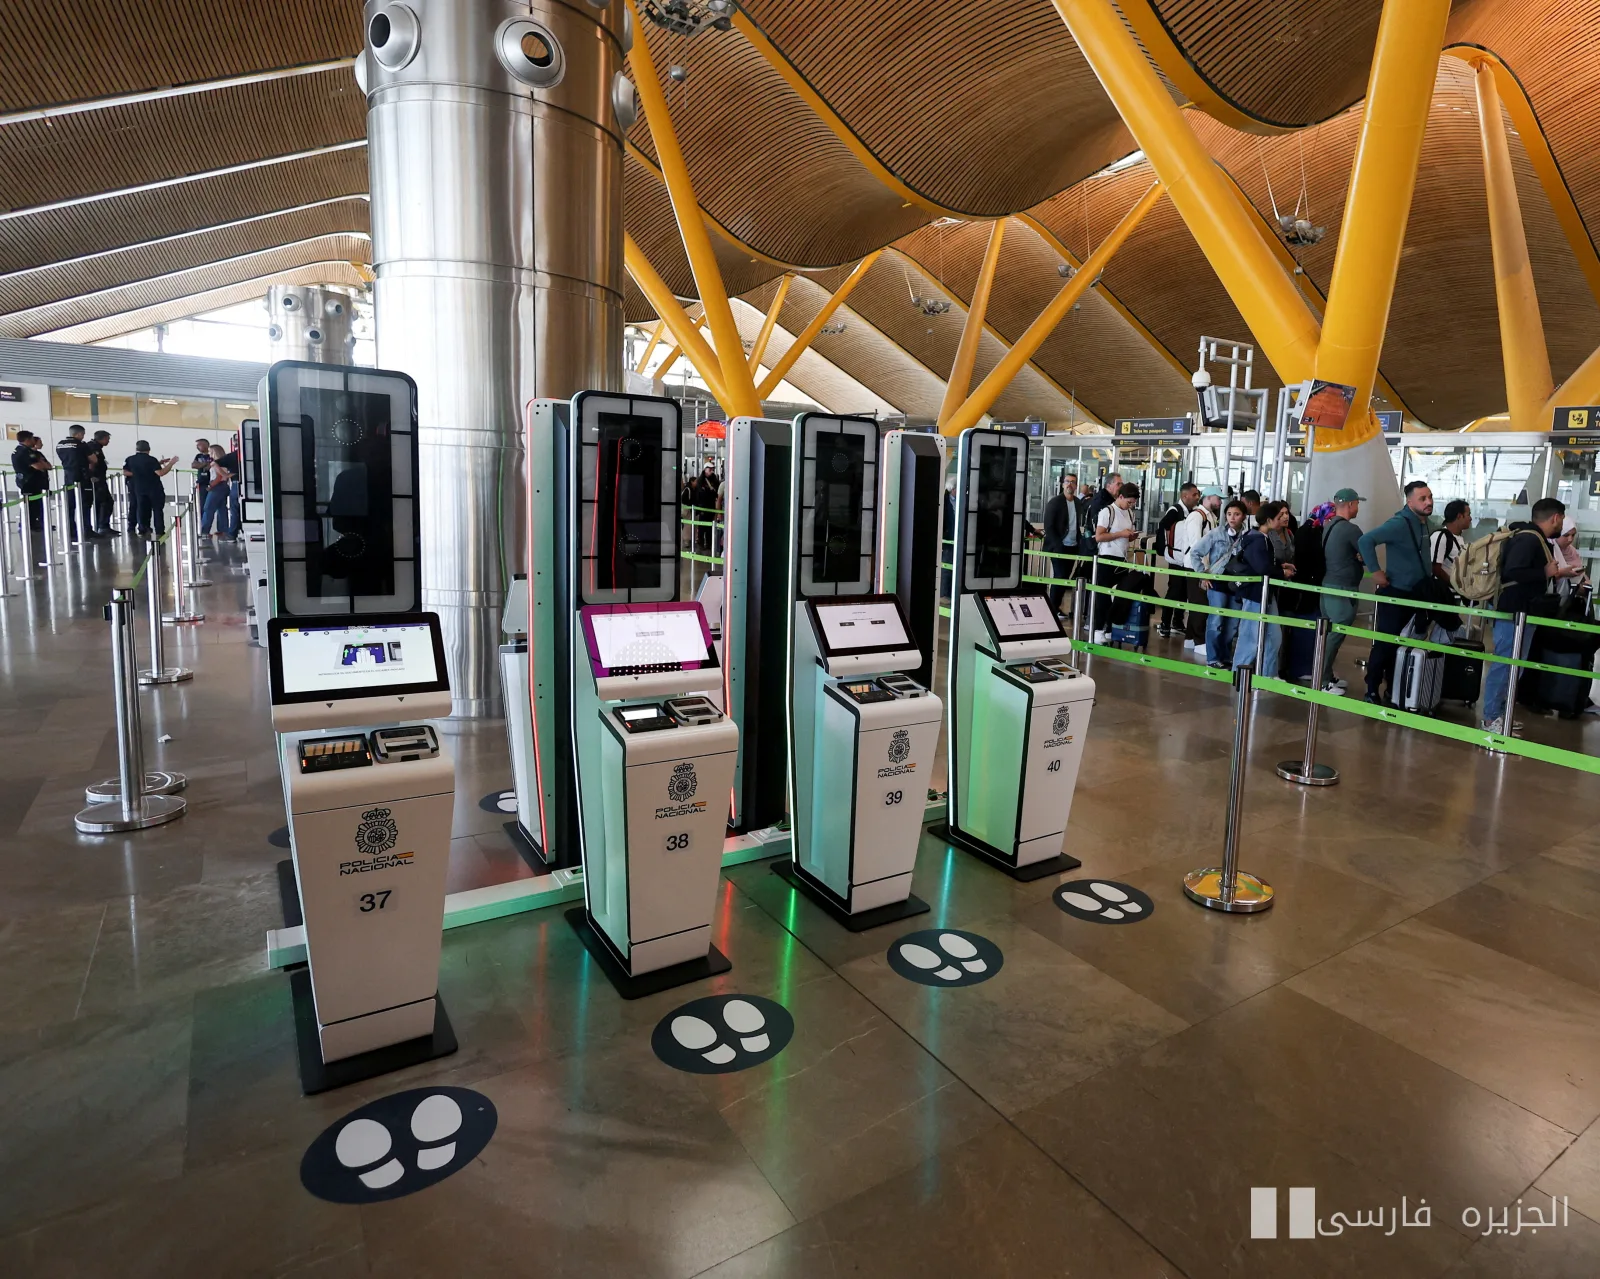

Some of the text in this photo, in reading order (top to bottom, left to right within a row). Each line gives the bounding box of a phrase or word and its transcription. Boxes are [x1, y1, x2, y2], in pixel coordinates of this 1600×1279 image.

[1156, 467, 1167, 477] 10
[878, 764, 908, 774] POLICIA
[1047, 759, 1061, 772] 40
[877, 768, 915, 778] NACIONAL
[885, 790, 903, 805] 39
[654, 809, 706, 820] NACIONAL
[655, 804, 696, 814] POLICIA
[666, 833, 689, 851] 38
[339, 854, 399, 869] POLICIA
[339, 859, 414, 876] NACIONAL
[359, 890, 392, 913] 37
